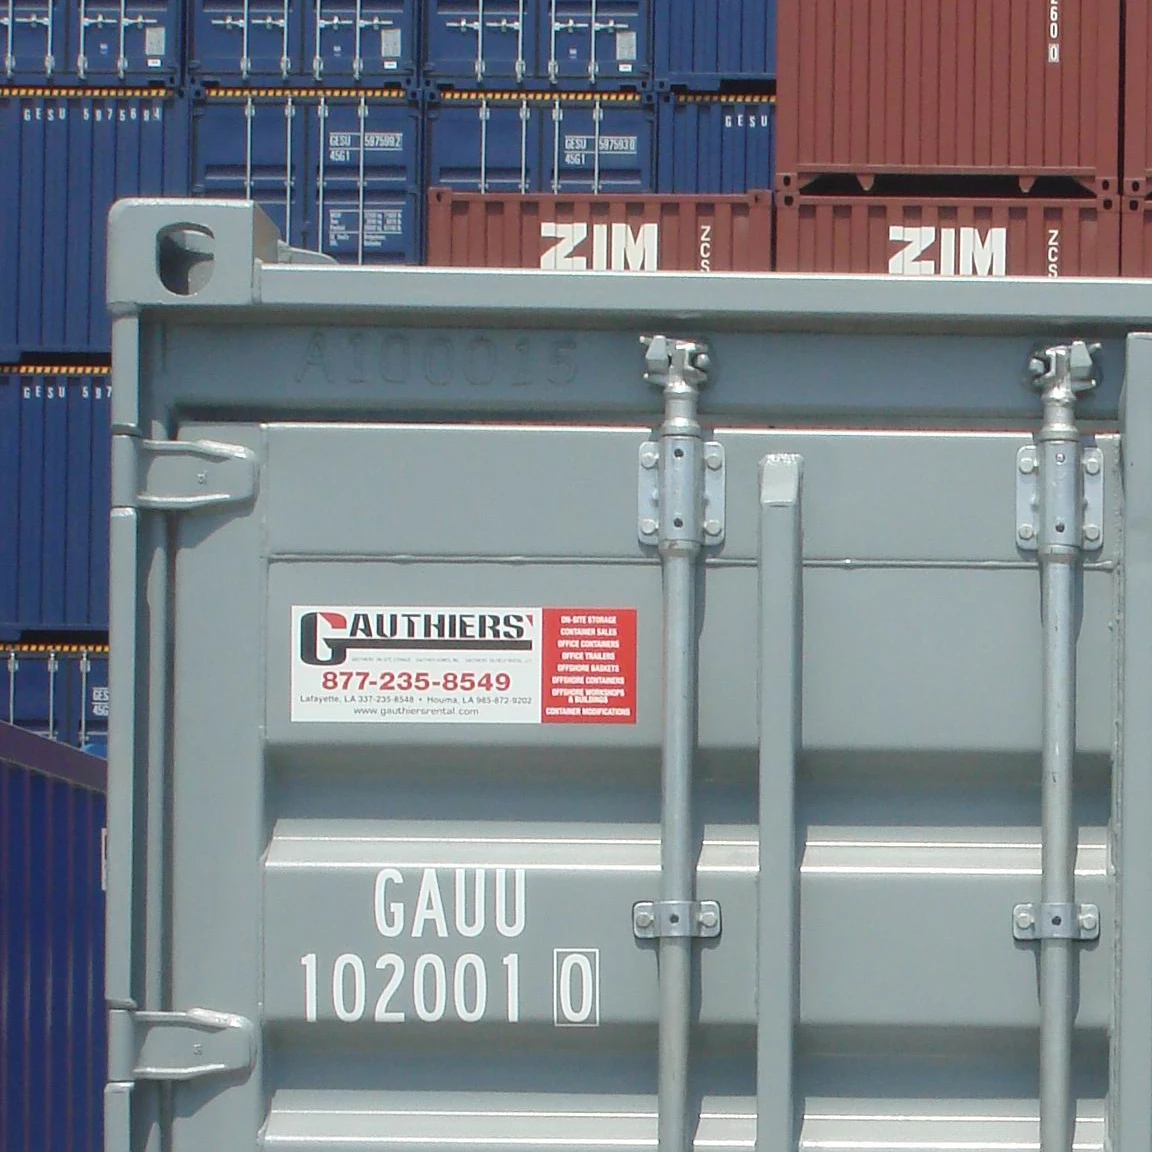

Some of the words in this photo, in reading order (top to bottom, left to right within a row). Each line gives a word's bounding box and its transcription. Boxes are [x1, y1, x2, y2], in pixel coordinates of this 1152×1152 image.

[1050, 0, 1058, 38] 60
[24, 107, 66, 121] GESU
[725, 115, 768, 127] GESU
[540, 222, 658, 270] ZIM
[889, 225, 1007, 276] ZIM
[23, 385, 66, 399] GESU
[322, 671, 511, 691] 877-235-8549
[344, 694, 357, 703] LA
[462, 695, 475, 704] LA
[373, 868, 527, 938] GAUU
[300, 952, 519, 1023] 102001
